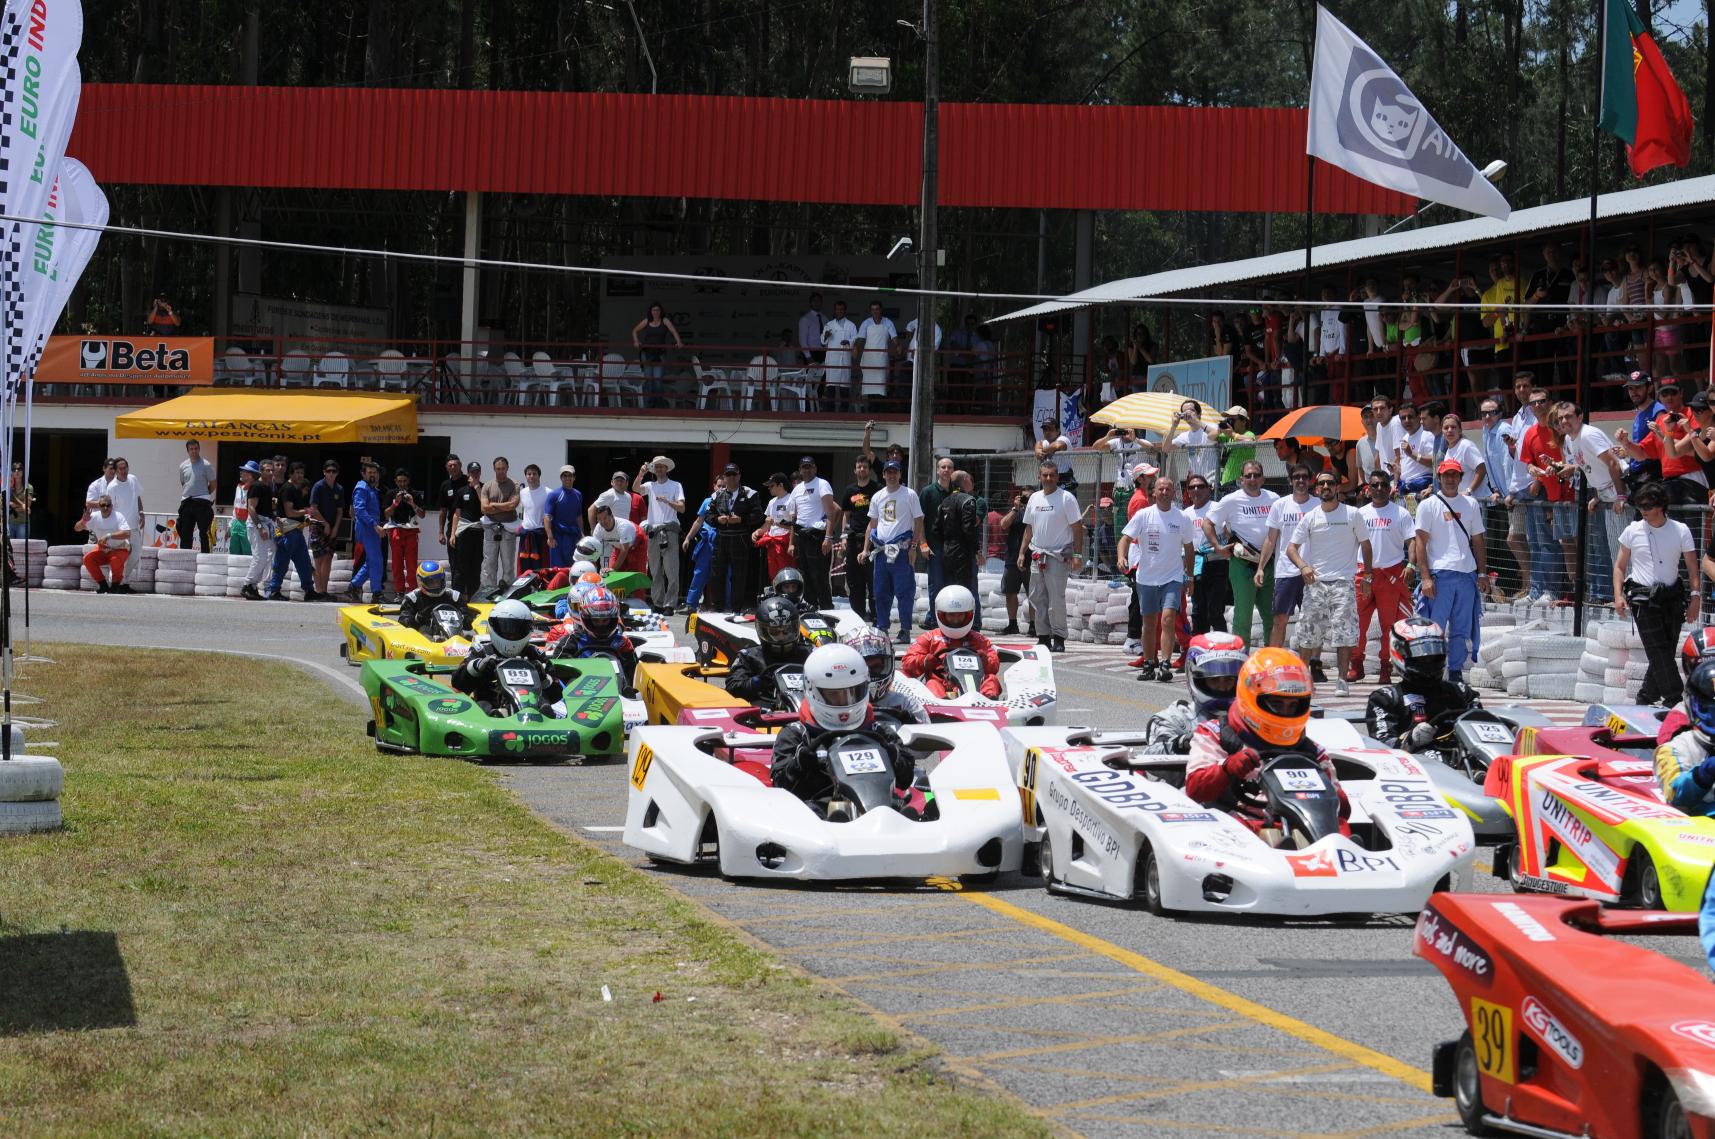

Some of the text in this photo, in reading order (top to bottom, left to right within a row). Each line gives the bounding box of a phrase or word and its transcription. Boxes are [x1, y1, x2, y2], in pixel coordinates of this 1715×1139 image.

[20, 55, 41, 140] EURO
[110, 340, 191, 371] Beta
[155, 429, 321, 441] www.pestronix.pt
[958, 655, 972, 663] 124
[527, 734, 569, 748] JOGOS
[1479, 724, 1501, 733] 125
[631, 743, 654, 786] 129
[846, 750, 874, 761] 129
[1023, 752, 1037, 789] 90
[1286, 770, 1308, 779] 90
[1049, 781, 1120, 861] Grupo Desportivo BPI
[1542, 791, 1592, 846] UNITRIP
[1336, 848, 1401, 873] BPI
[1520, 873, 1569, 895] BRIDGESTONE
[1434, 931, 1458, 956] and
[1453, 945, 1488, 975] more
[1478, 1006, 1505, 1075] 39
